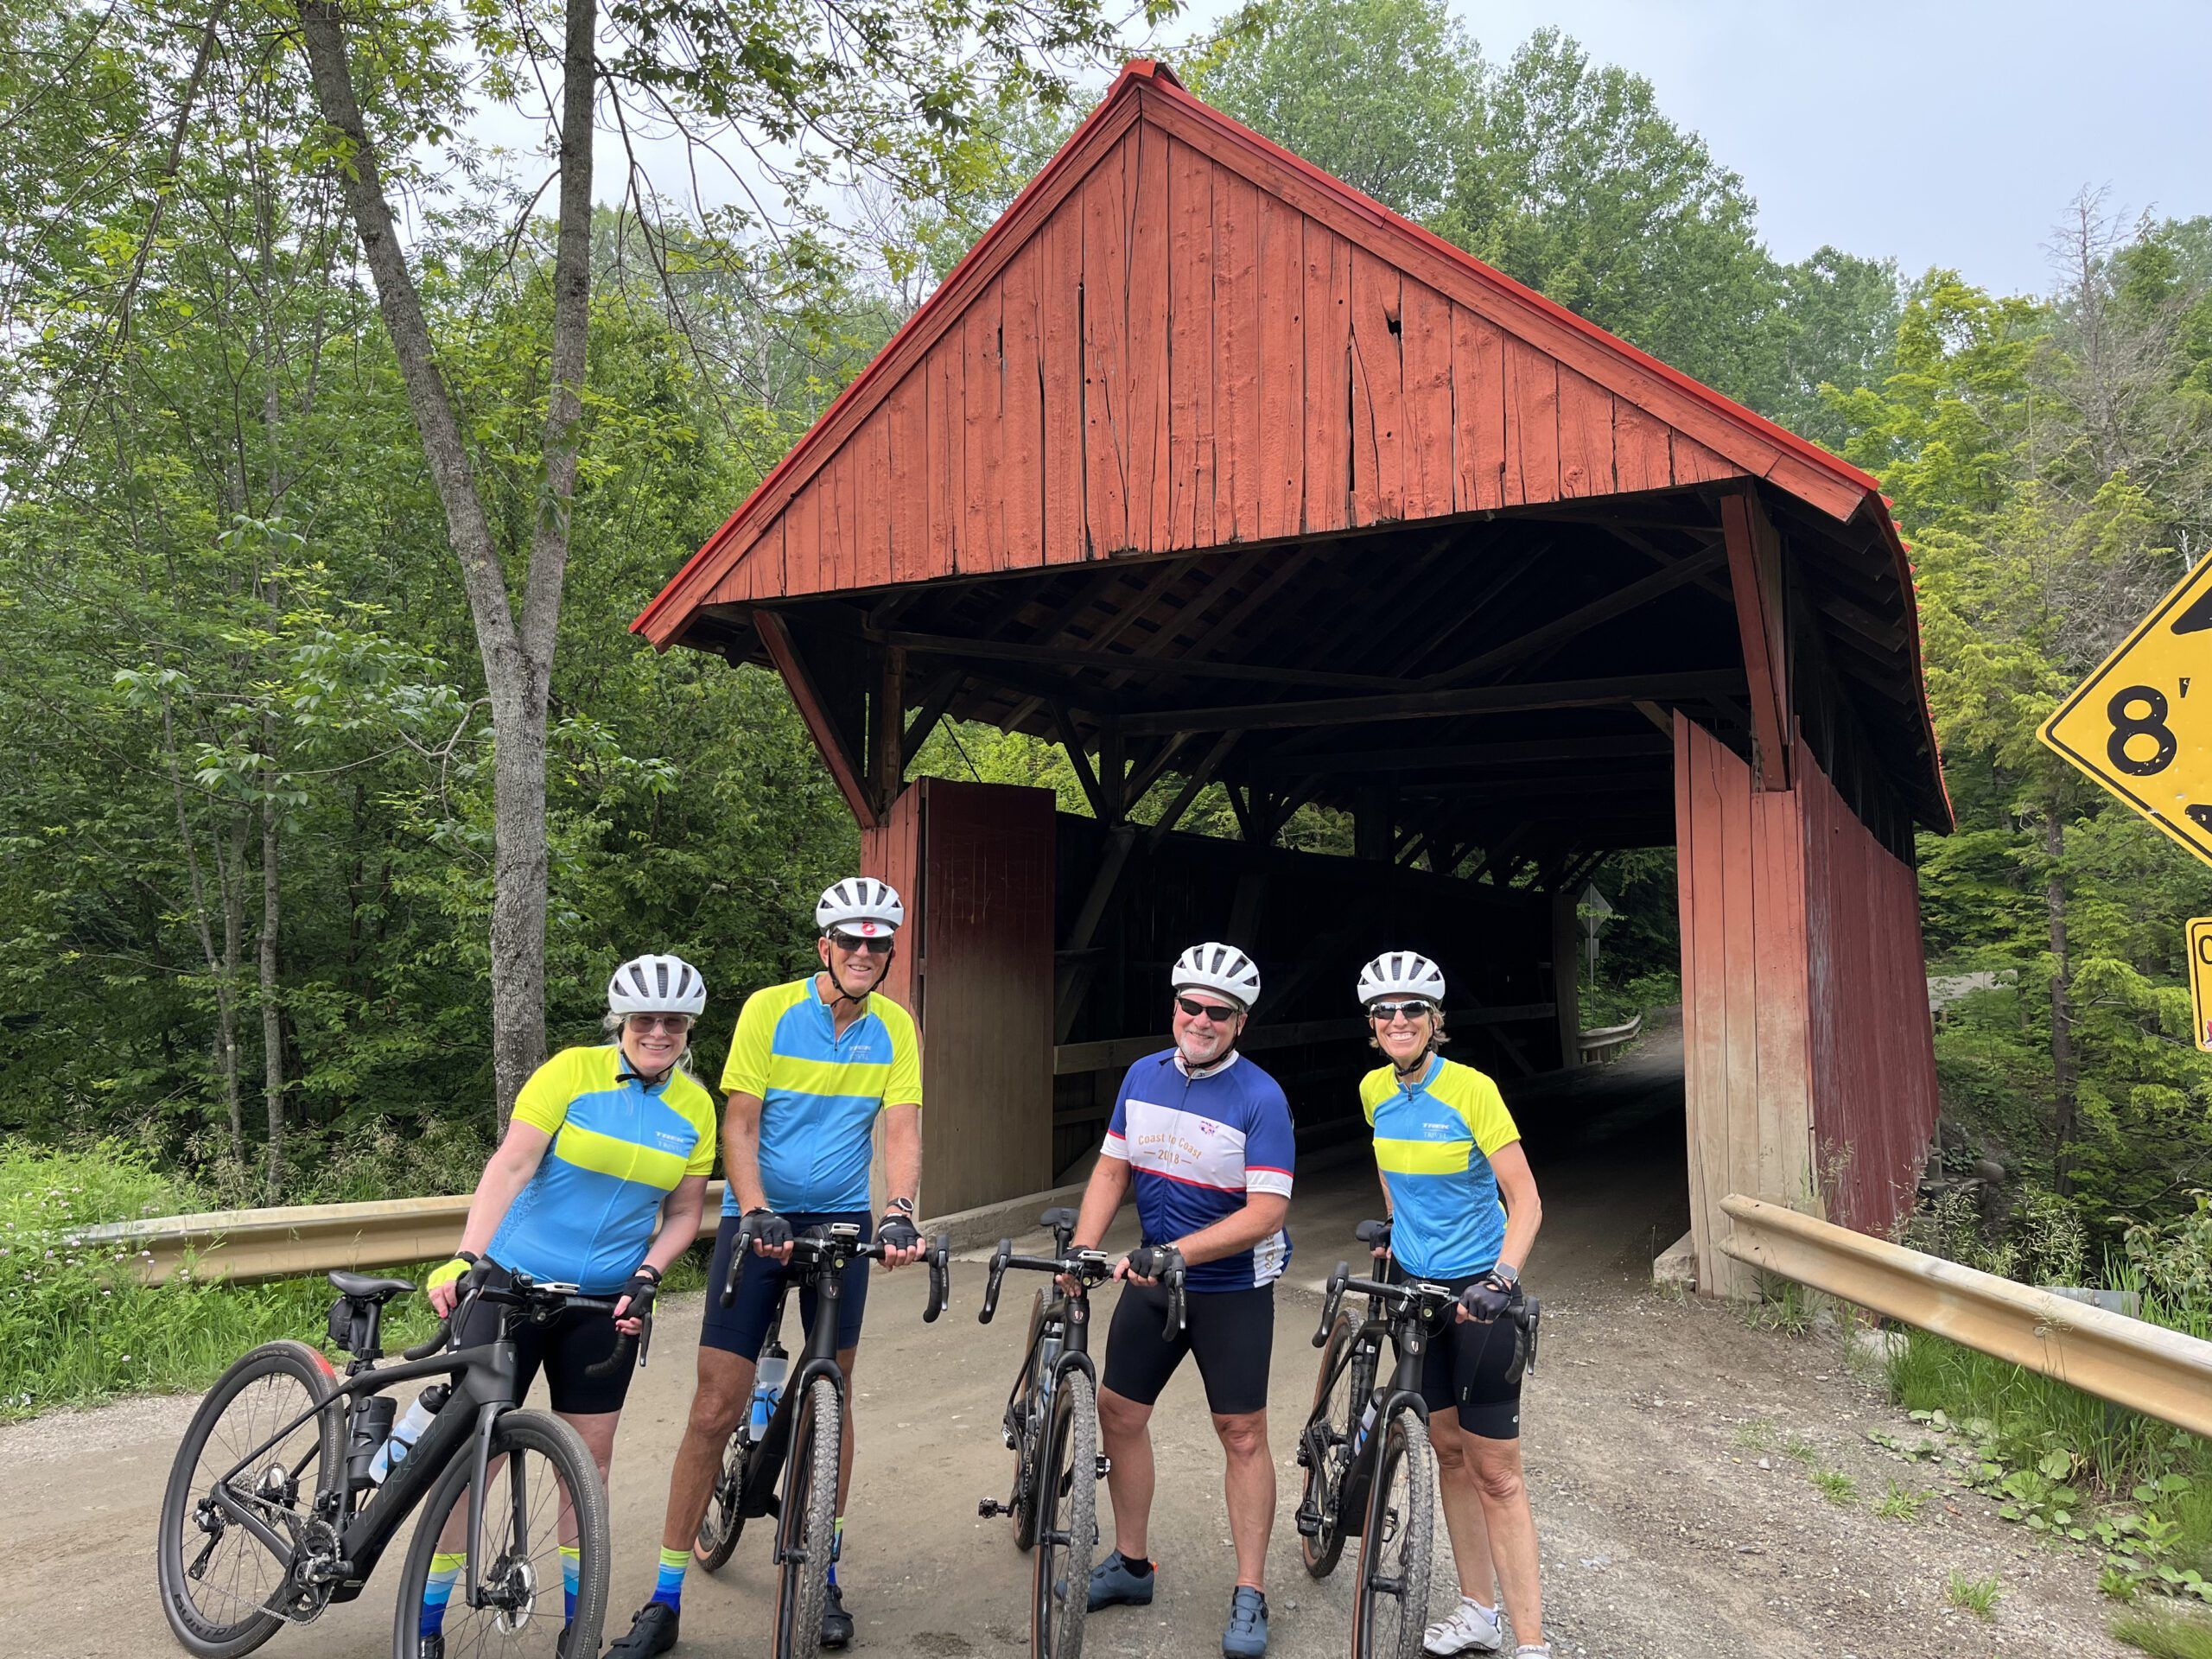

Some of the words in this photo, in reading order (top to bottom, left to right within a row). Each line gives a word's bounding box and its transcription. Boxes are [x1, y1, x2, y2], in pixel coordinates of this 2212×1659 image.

[1138, 1134, 1165, 1146] Coast
[1168, 1134, 1177, 1145] to
[1179, 1137, 1202, 1160] Coast
[1158, 1149, 1179, 1165] 2018
